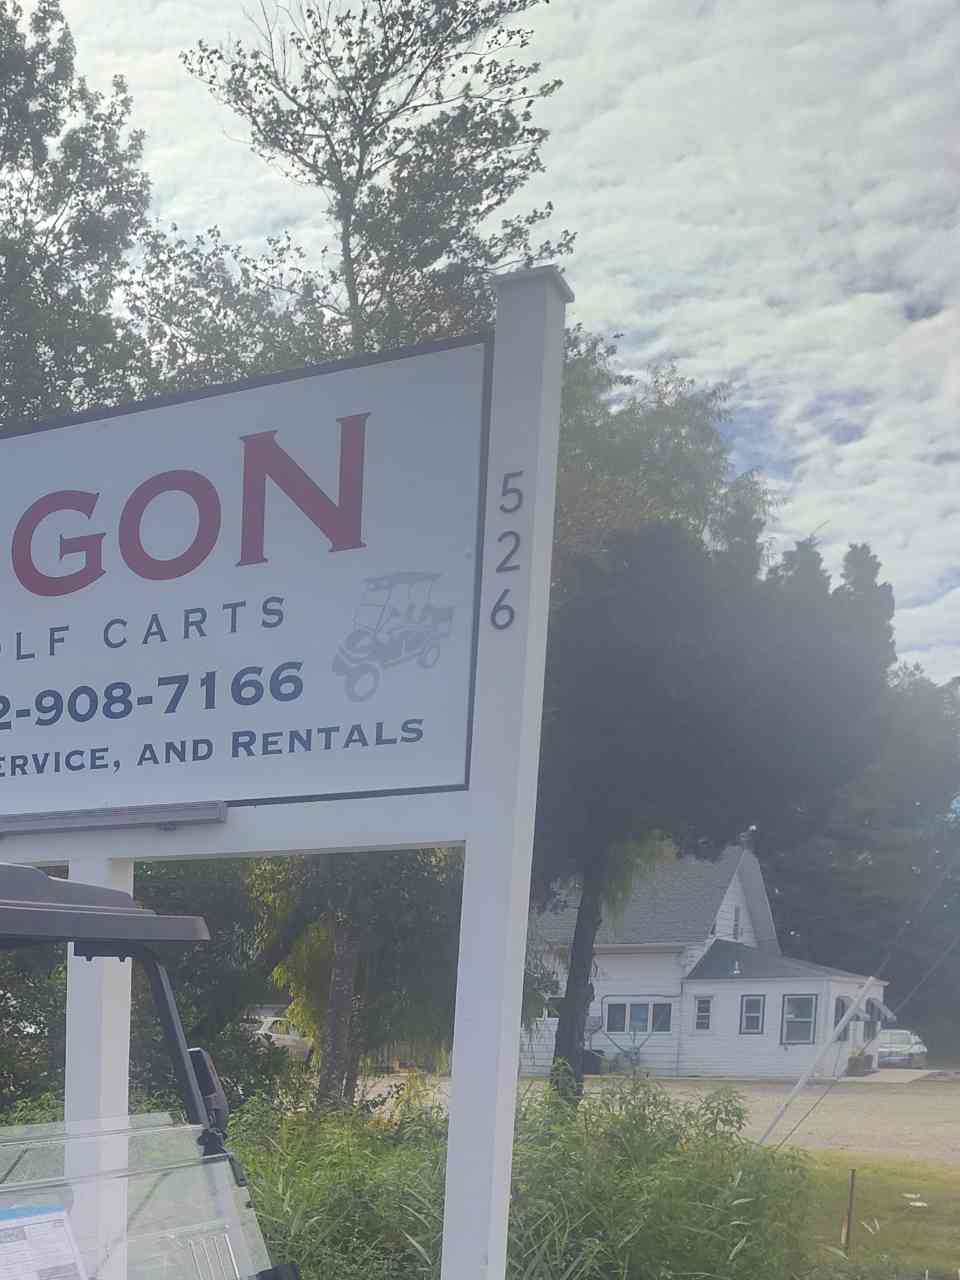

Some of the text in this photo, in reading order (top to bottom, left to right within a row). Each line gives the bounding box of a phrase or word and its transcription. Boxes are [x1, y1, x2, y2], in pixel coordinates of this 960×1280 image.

[491, 470, 524, 630] 526
[103, 596, 285, 649] CARTS
[137, 738, 214, 767] AND
[230, 718, 424, 759] RENTALS
